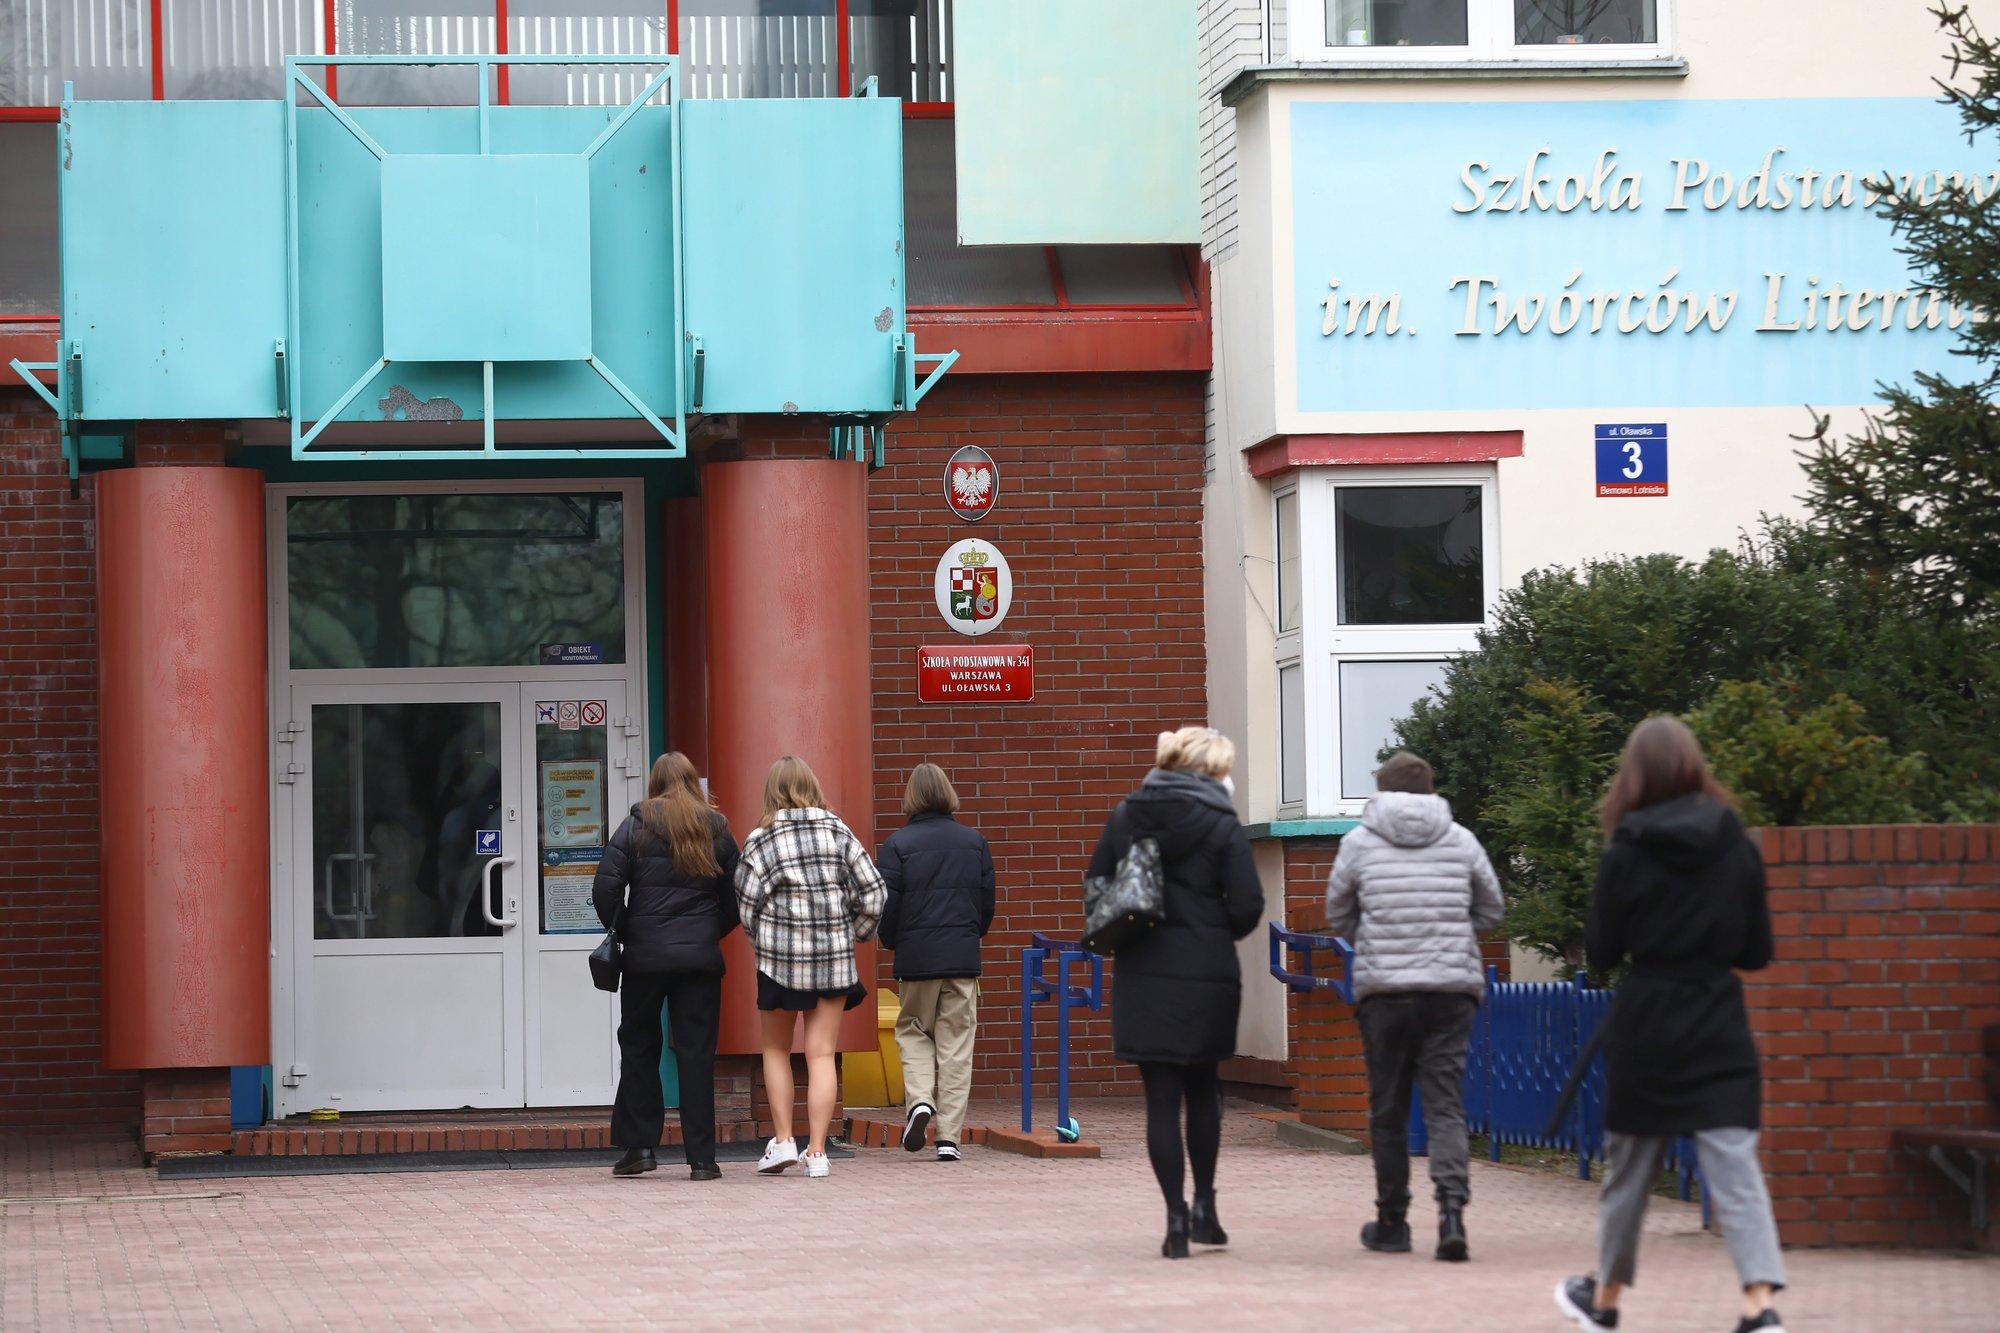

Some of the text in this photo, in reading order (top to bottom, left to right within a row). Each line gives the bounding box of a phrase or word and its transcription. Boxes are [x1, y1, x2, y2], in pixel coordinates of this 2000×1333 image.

[1451, 146, 1643, 213] Szkoła
[1320, 278, 1416, 336] im.
[1449, 268, 1737, 335] Twórców
[1608, 427, 1619, 436] ul.
[1622, 441, 1643, 479] 3
[1600, 485, 1665, 495] Bemowo Lotnisko
[568, 646, 592, 654] OBIEKT
[922, 655, 1030, 668] SZKOŁA PODSTAWOWA Nr 341
[950, 671, 1002, 680] WARSZAWA
[941, 683, 1011, 692] UL. OŁAWSKA 3
